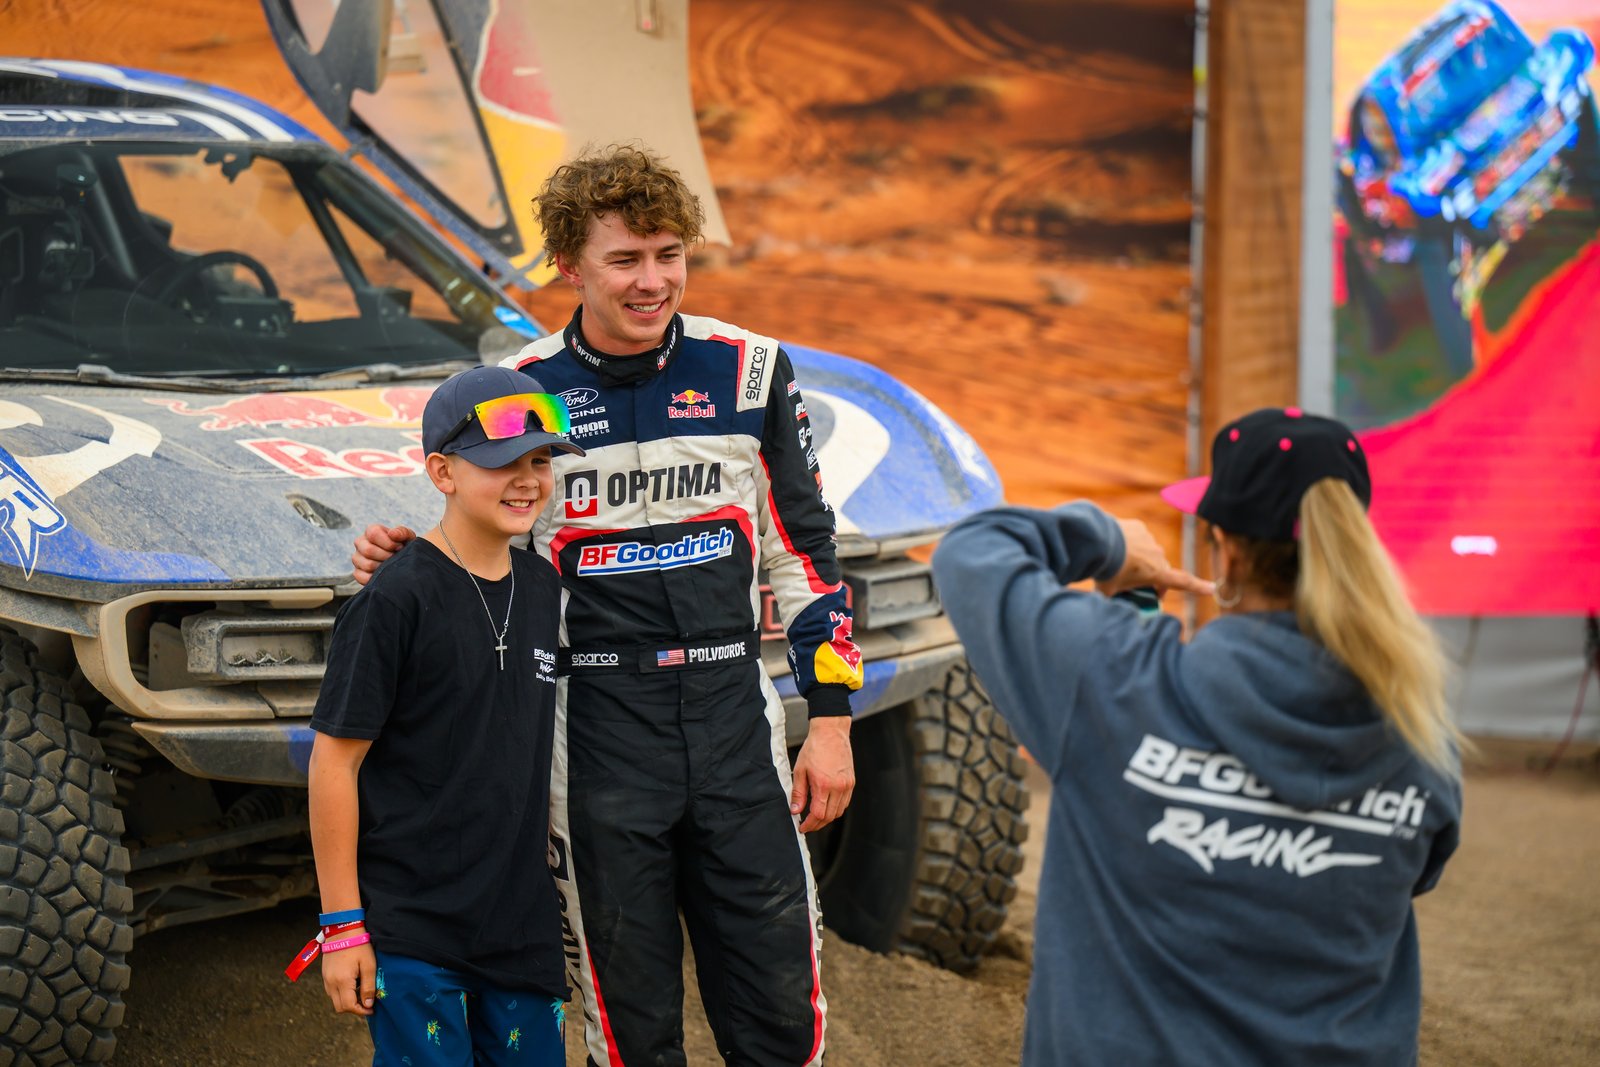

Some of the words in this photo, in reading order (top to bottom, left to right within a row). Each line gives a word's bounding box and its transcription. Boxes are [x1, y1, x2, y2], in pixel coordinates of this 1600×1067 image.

[745, 346, 766, 401] sparco
[561, 391, 589, 407] Ford
[569, 406, 606, 419] CING
[668, 407, 691, 418] Red
[692, 404, 716, 418] Bull
[236, 433, 424, 480] Re
[607, 462, 721, 507] OPTIMA
[580, 528, 733, 566] BFGoodrich
[572, 653, 619, 666] sparco
[1147, 806, 1383, 877] RACING
